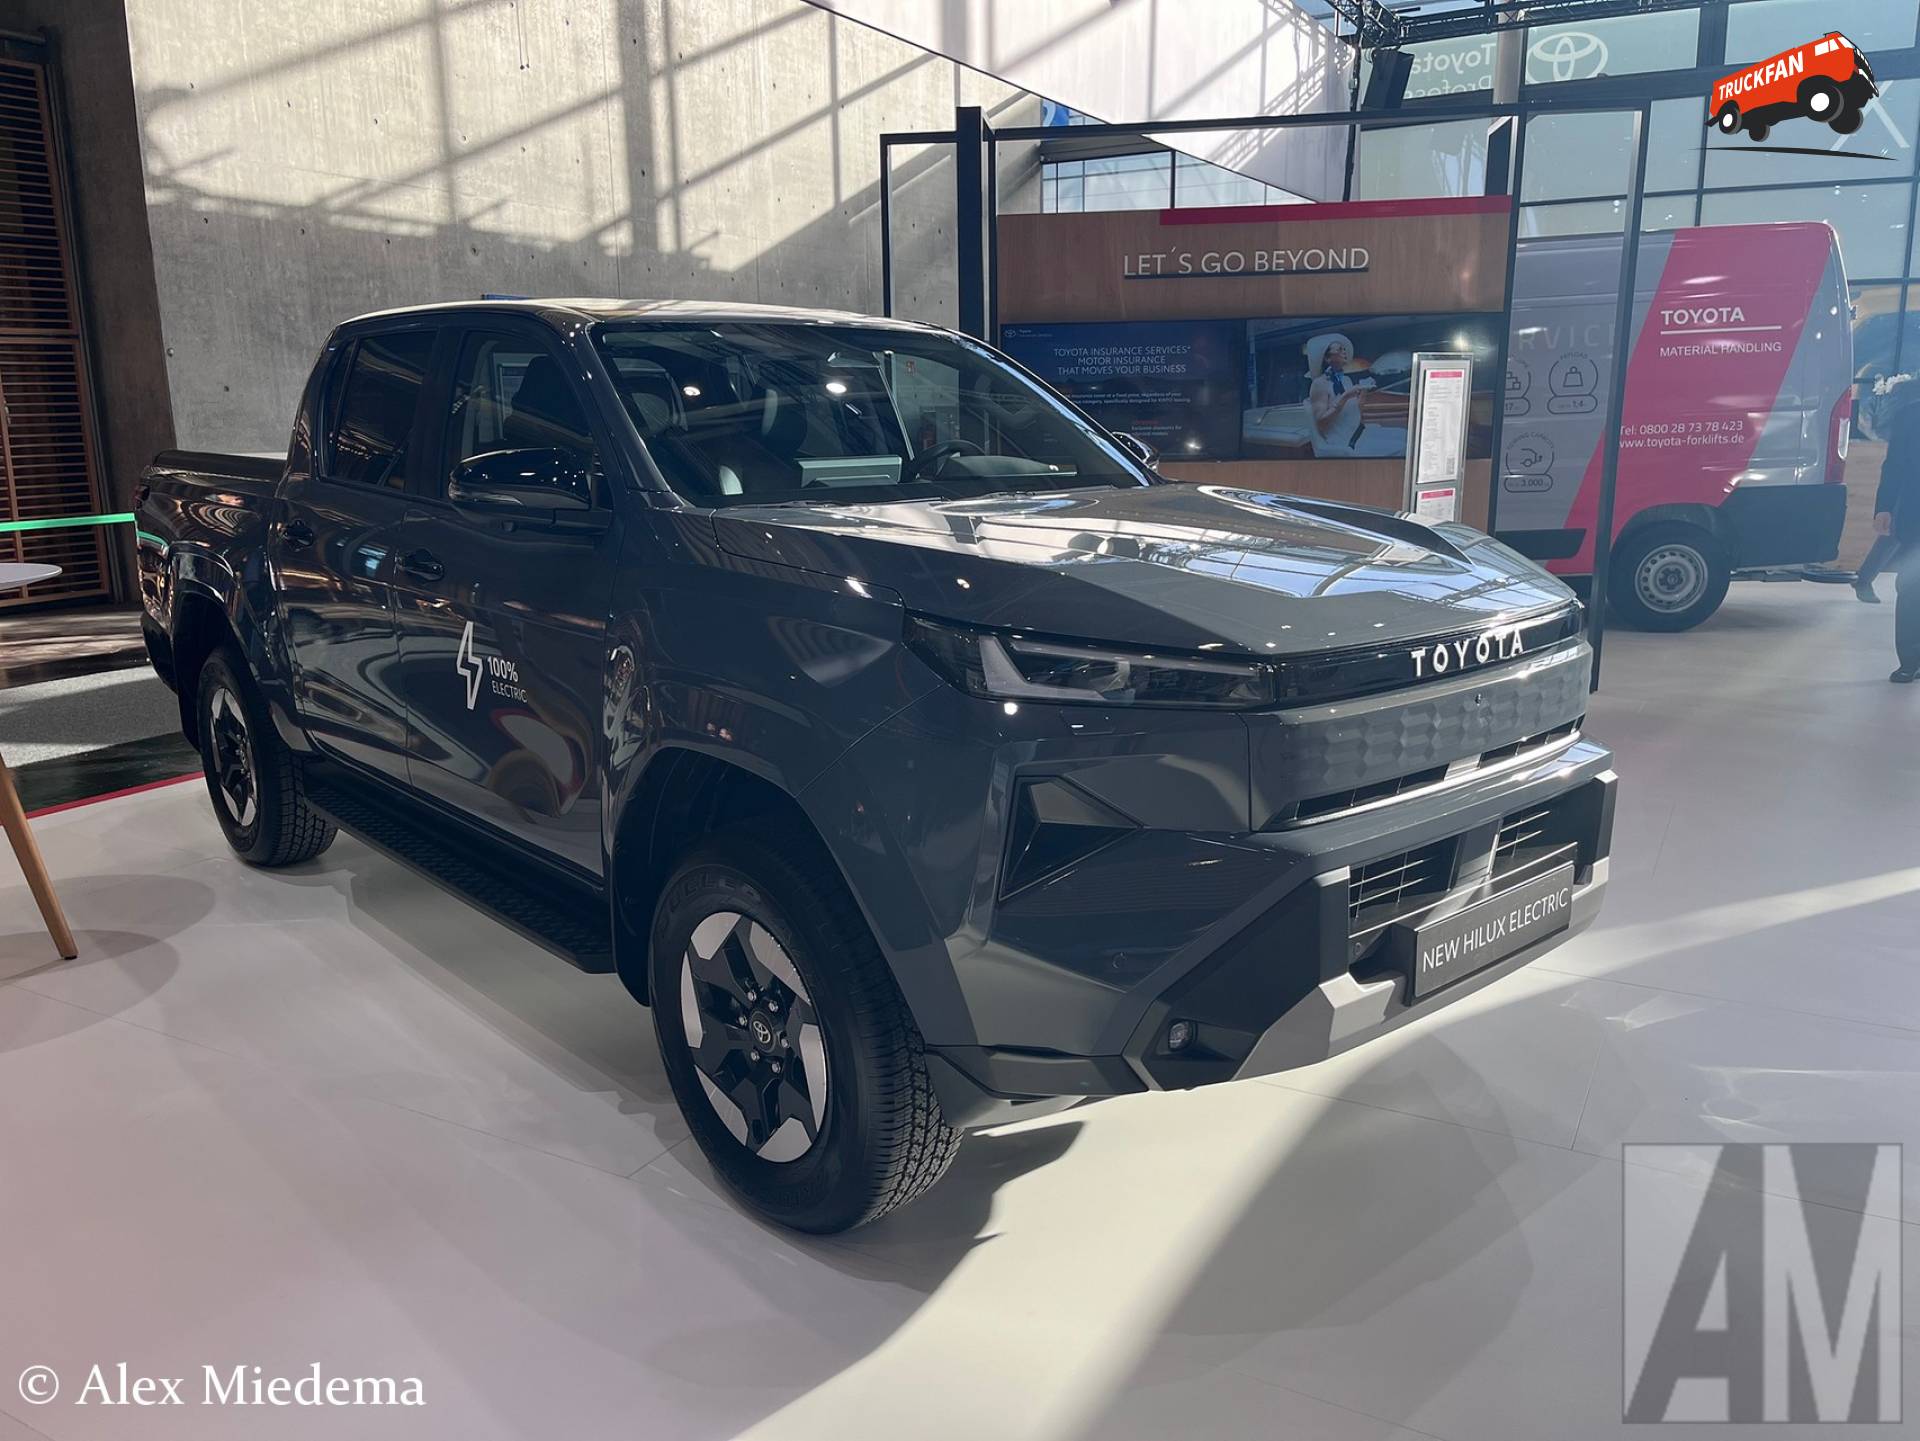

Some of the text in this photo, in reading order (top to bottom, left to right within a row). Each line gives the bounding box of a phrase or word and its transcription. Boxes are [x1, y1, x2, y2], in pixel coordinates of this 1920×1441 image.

[1201, 251, 1245, 273] GO
[1254, 248, 1369, 272] BEYOND
[1660, 307, 1745, 325] TOYOTA
[1054, 347, 1089, 357] TOYOTA
[1091, 346, 1143, 356] INSURANCE
[1659, 342, 1782, 357] MATERIAL HANDLING
[1058, 363, 1187, 376] THAT MOVES YOUR BUSINESS
[1077, 355, 1166, 366] MOTOR INSURANCE
[1639, 423, 1668, 435] 0800
[1671, 422, 1685, 434] 28
[1688, 422, 1701, 433] 73
[1705, 421, 1719, 432] 78
[1722, 420, 1744, 432] 423
[1410, 627, 1525, 678] TOYOTA
[487, 655, 519, 683] 100%
[491, 680, 528, 704] ELECTRIC
[1422, 887, 1569, 974] NEW HILUX ELECTRIC
